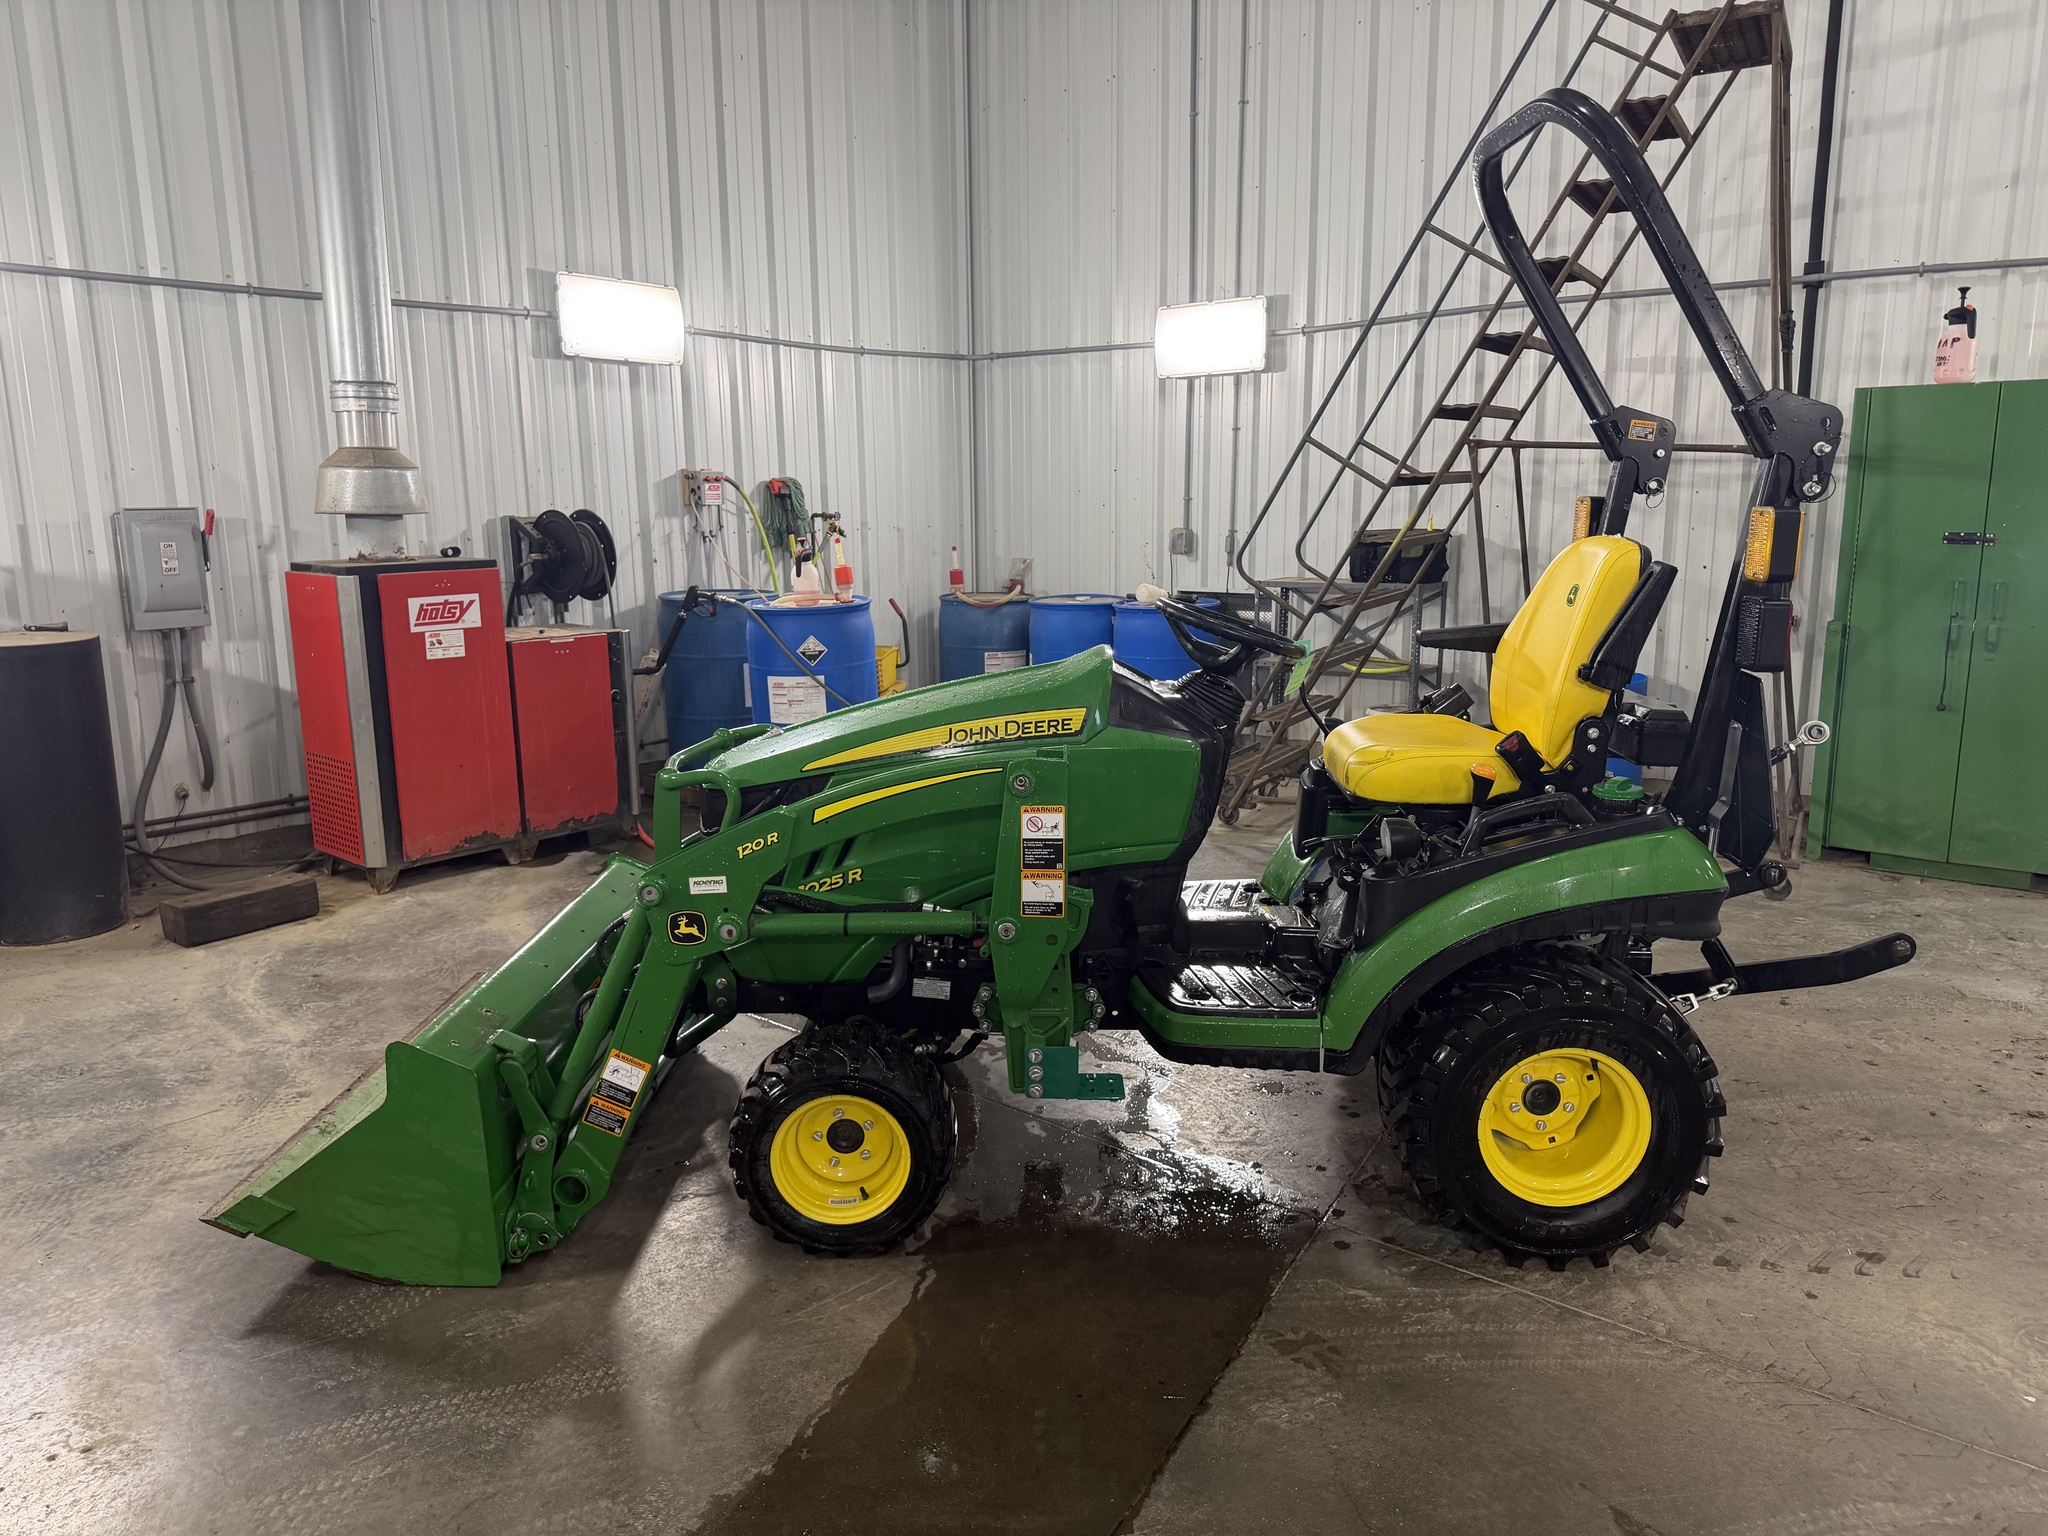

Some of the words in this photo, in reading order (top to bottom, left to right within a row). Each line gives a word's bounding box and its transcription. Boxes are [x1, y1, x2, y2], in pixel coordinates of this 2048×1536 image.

[414, 599, 476, 627] hotsy
[947, 724, 999, 743] JOHN
[1004, 718, 1073, 737] DEERE
[736, 837, 766, 860] 120
[766, 831, 780, 847] R
[847, 868, 863, 885] R
[621, 1055, 646, 1069] WARNING
[601, 1103, 626, 1116] WARNING
